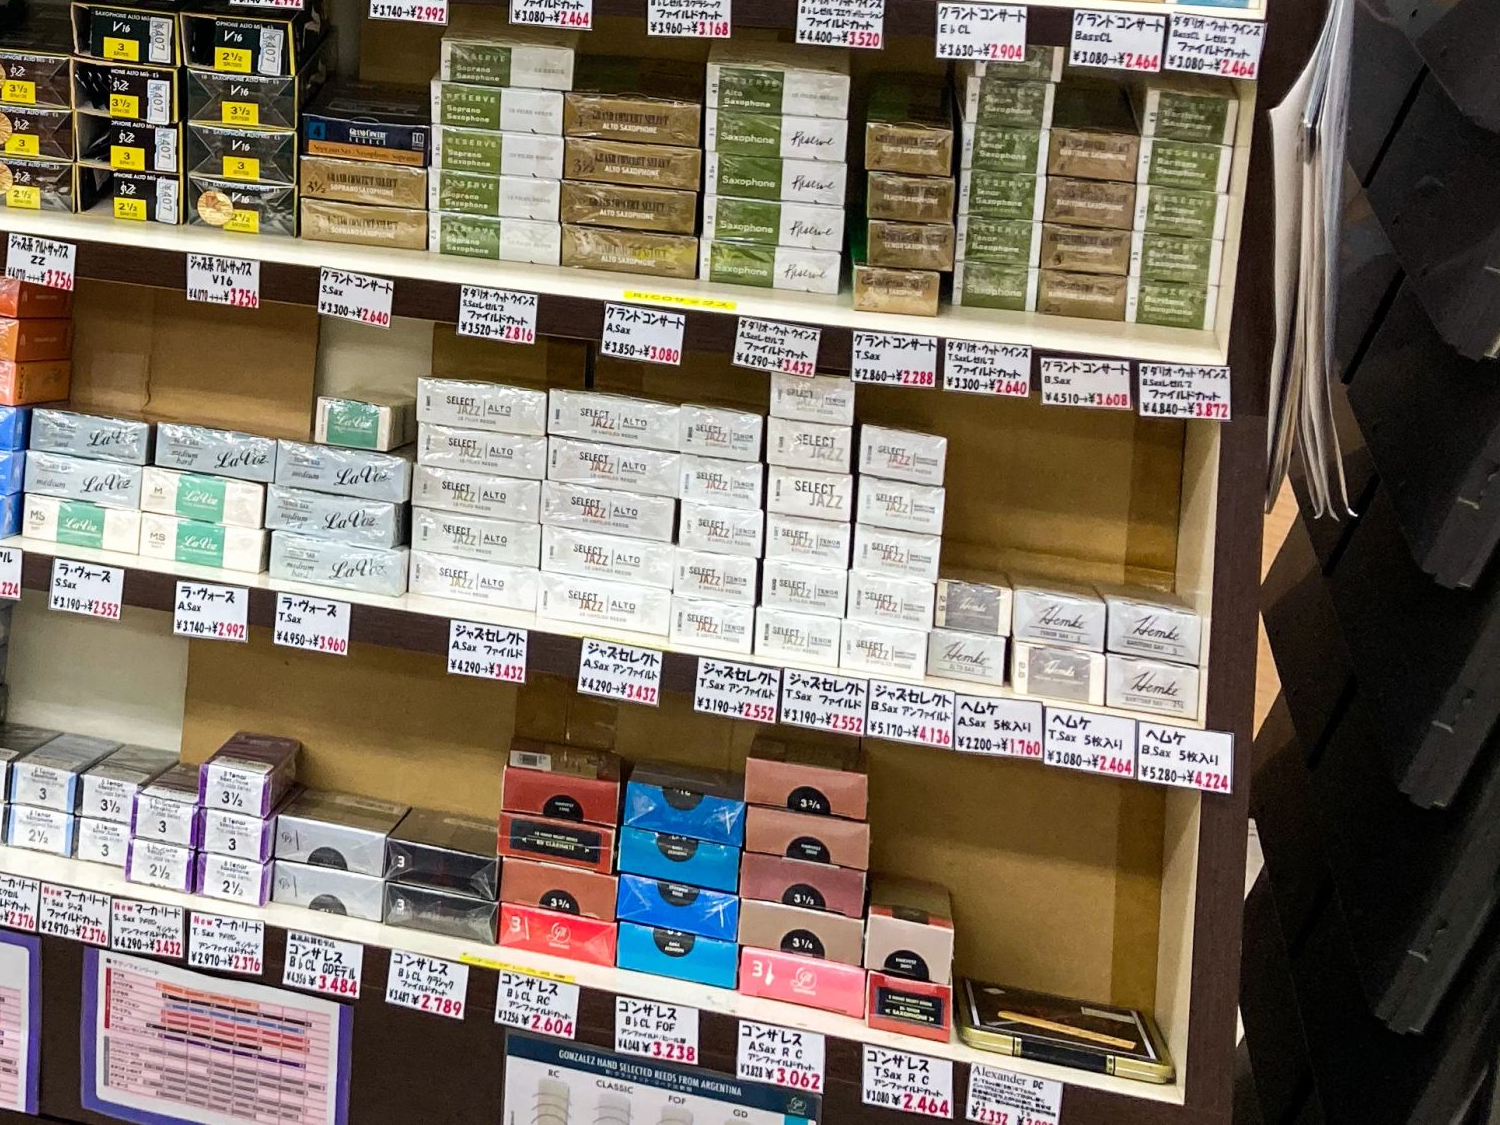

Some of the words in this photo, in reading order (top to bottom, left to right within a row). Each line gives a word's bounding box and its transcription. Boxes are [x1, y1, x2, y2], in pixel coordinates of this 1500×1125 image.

[721, 134, 775, 145] Saxophone
[30, 256, 45, 266] ZZ
[447, 396, 474, 406] SELECT
[488, 404, 511, 413] ALTO
[580, 452, 608, 463] SELECT
[589, 461, 614, 474] JAZZ
[622, 462, 646, 471] ALTO
[794, 481, 835, 496] SELECT
[809, 492, 843, 510] JAZZ
[455, 624, 525, 645] ジャズセレクト
[1131, 671, 1179, 697] Hemke
[961, 701, 998, 716] ヘムケ
[1145, 729, 1186, 745] ヘムケ
[558, 1049, 596, 1066] GONZALEZ
[596, 1056, 618, 1070] HAND
[619, 1060, 652, 1078] SELECTED
[654, 1068, 677, 1083] REEDS
[678, 1073, 699, 1087] FROM
[701, 1080, 742, 1097] ARGENTINA
[973, 1065, 1027, 1086] Alexander
[1033, 1080, 1044, 1090] DC
[596, 1080, 634, 1094] CLASSIC
[668, 1095, 686, 1105] FOF
